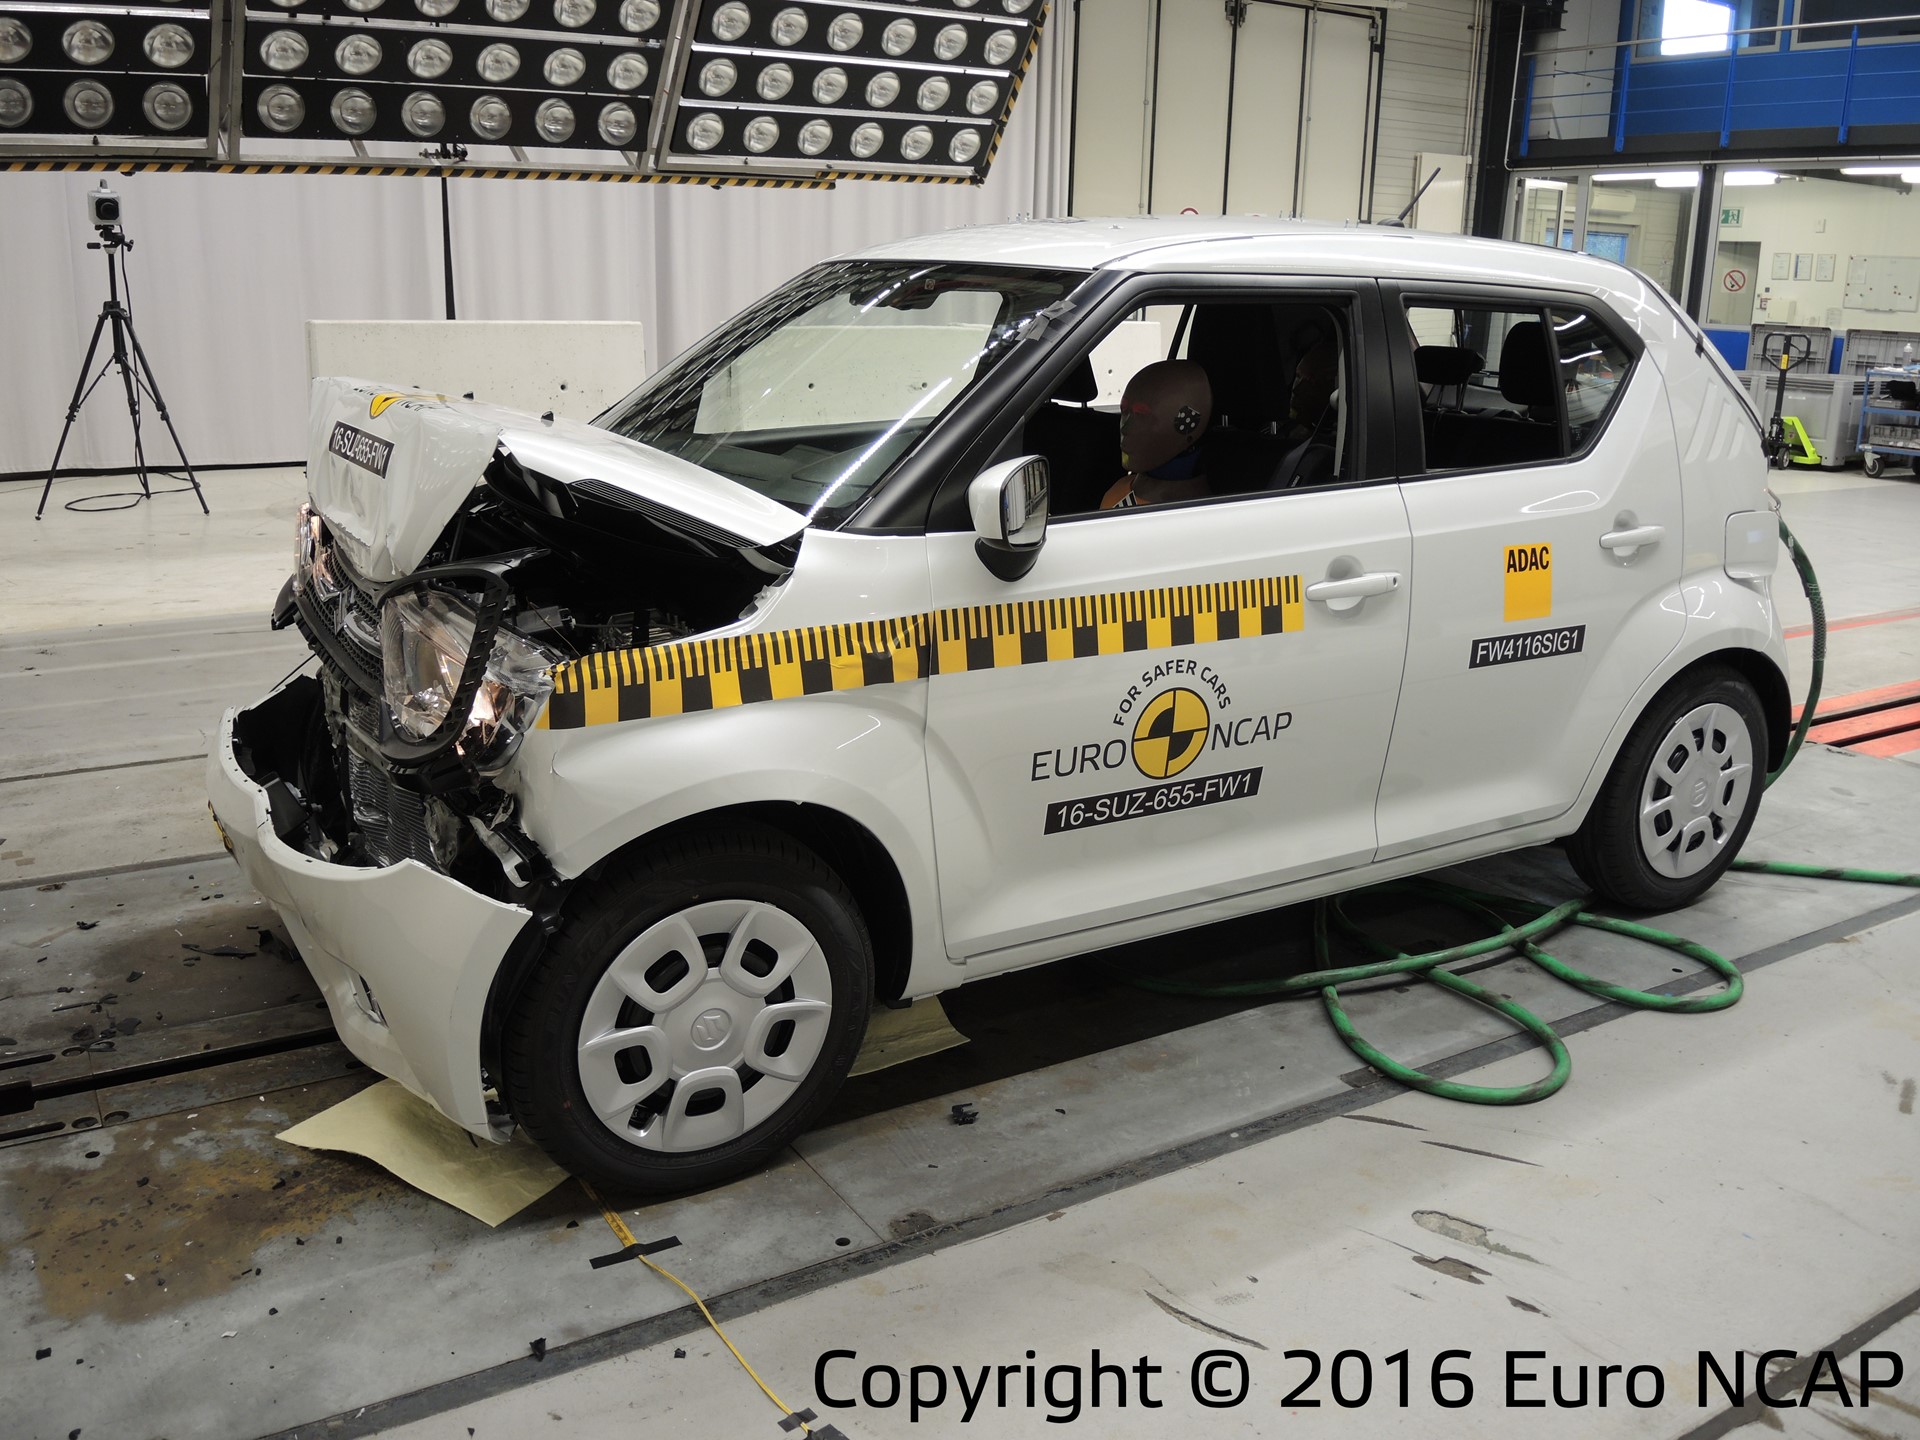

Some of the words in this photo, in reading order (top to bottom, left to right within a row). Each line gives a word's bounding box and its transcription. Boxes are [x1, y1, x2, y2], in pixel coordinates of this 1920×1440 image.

[1506, 545, 1550, 573] ADAC
[1475, 629, 1579, 665] FW4116SIG1
[1112, 685, 1142, 726] FOR
[1141, 658, 1198, 688] SAFER
[1200, 666, 1232, 710] CARS
[1031, 738, 1127, 782] EURO
[1211, 711, 1293, 751] NCAP
[1056, 772, 1252, 828] 16-SUZ-655-FW1
